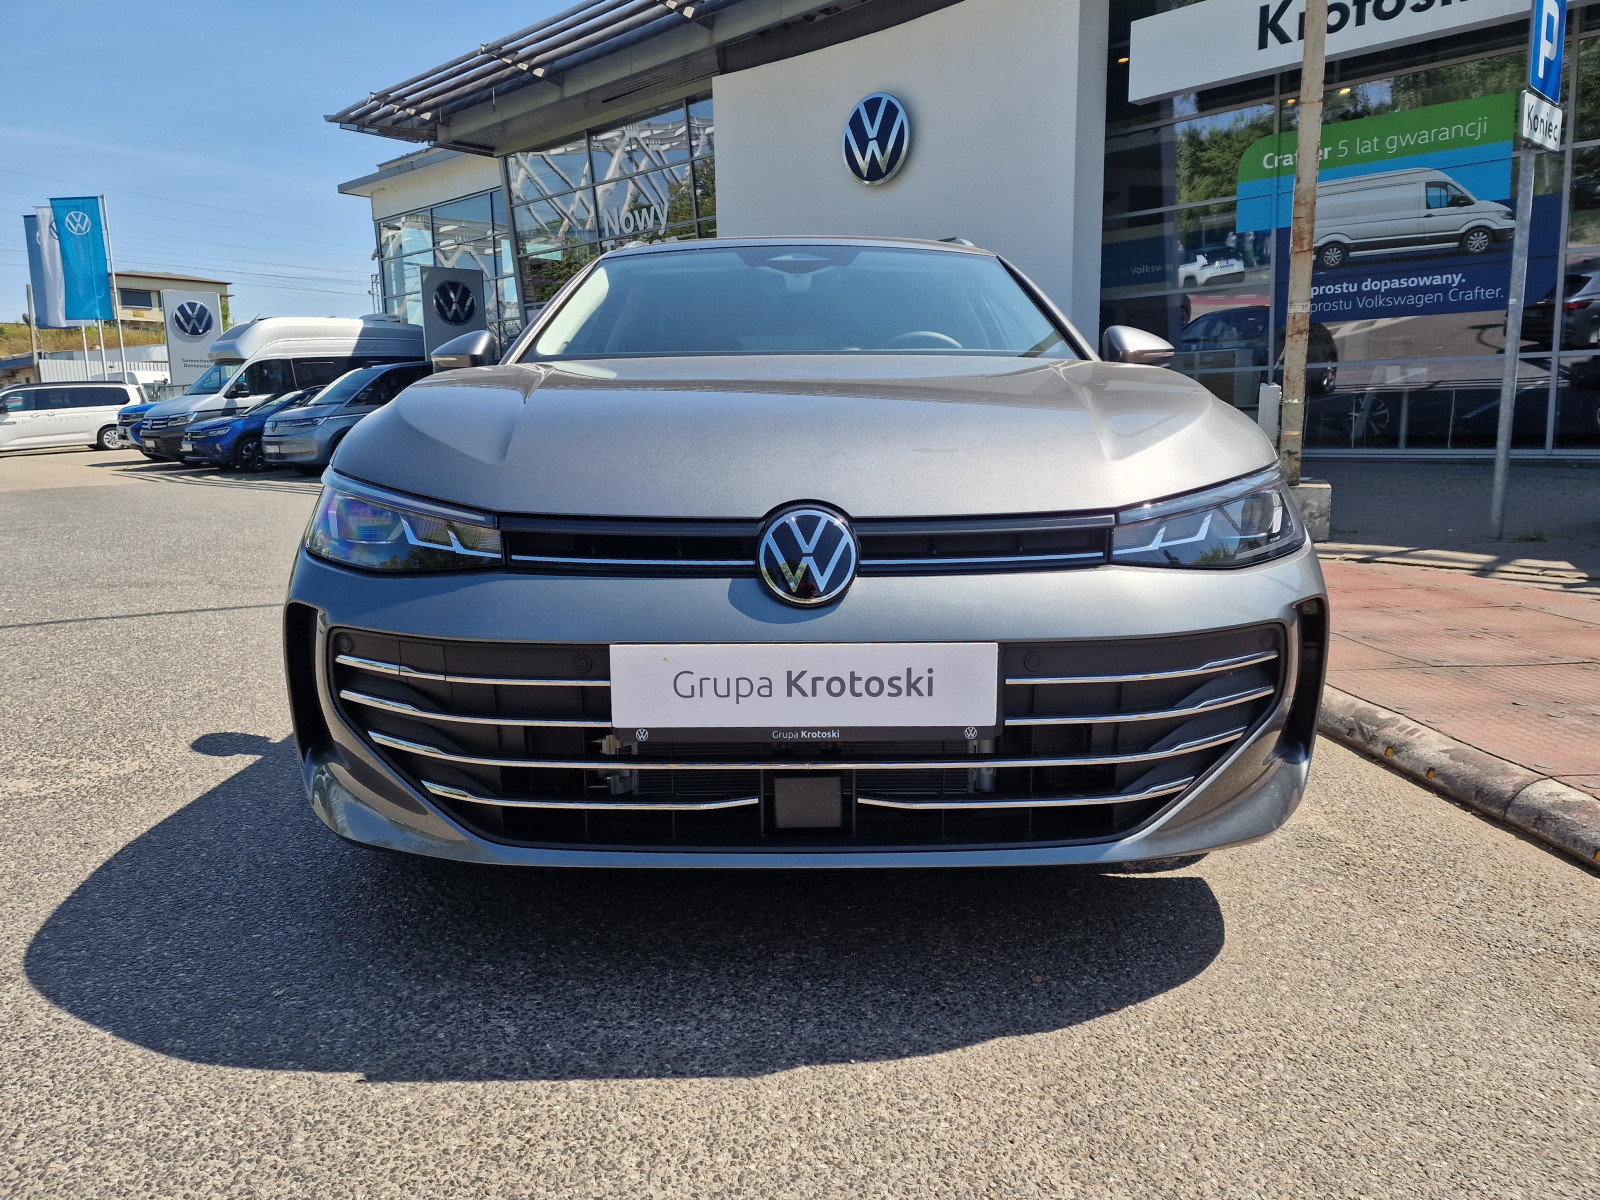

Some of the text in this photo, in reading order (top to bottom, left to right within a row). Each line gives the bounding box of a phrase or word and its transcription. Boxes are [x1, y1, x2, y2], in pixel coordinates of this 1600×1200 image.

[1257, 0, 1471, 50] Koto
[1537, 0, 1560, 79] P
[1527, 103, 1558, 141] Koniec
[1262, 116, 1488, 169] Crar 5 lat gwarancji
[603, 202, 669, 236] Nowy
[1310, 298, 1352, 315] prostu
[1356, 291, 1443, 309] Volkswagen
[1449, 286, 1504, 302] Crafter.
[1311, 272, 1466, 298] prostu dopasowany.
[672, 667, 934, 704] Grupa Krotoski
[772, 729, 840, 740] Grupa Krotoski
